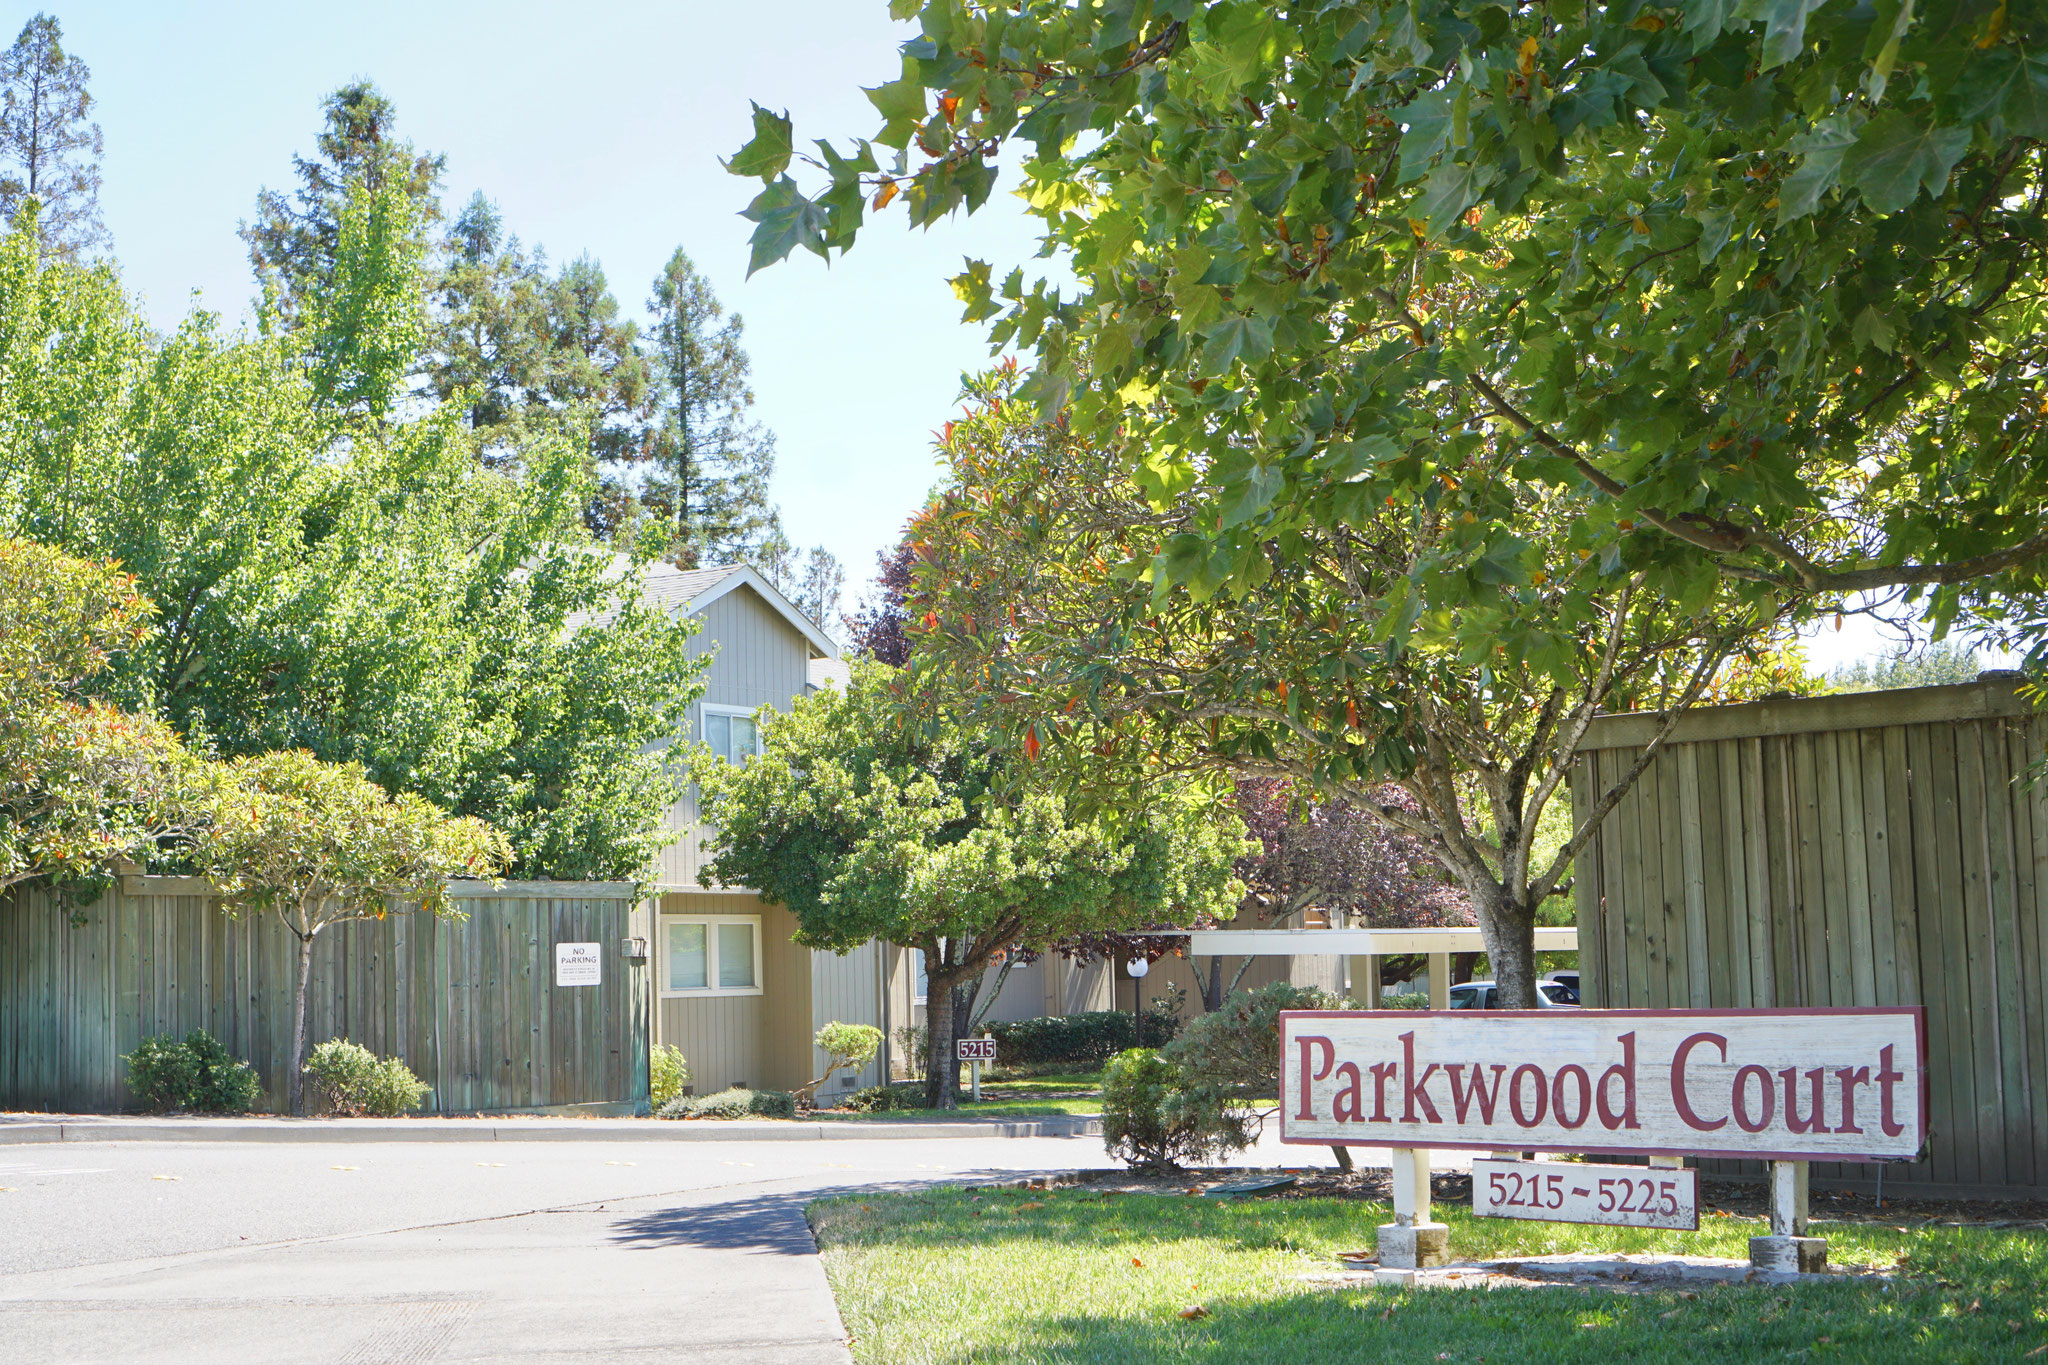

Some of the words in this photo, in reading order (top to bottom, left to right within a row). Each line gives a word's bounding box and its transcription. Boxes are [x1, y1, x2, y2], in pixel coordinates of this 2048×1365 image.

[561, 956, 597, 964] PARKING
[960, 1042, 994, 1057] 5215
[1294, 1030, 1641, 1130] Parkwood
[1670, 1032, 1904, 1137] Court
